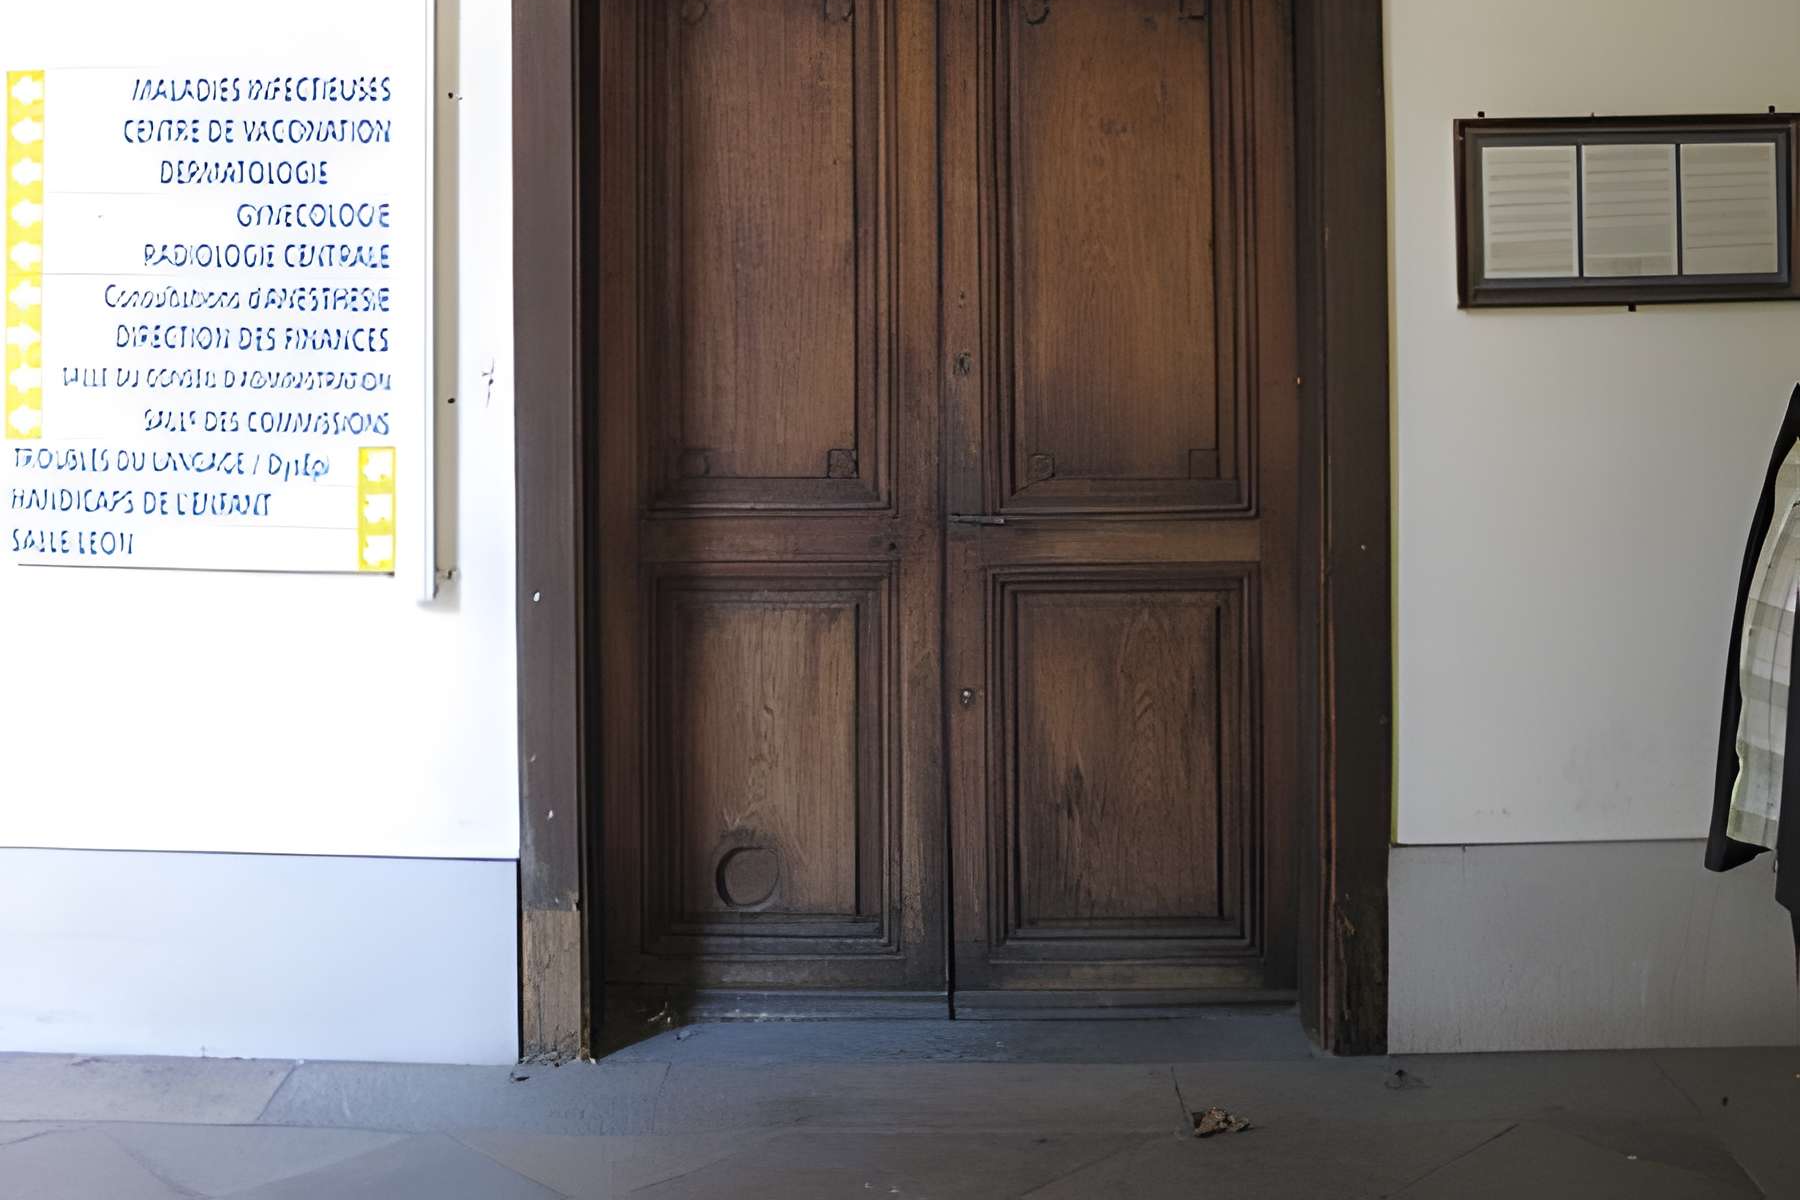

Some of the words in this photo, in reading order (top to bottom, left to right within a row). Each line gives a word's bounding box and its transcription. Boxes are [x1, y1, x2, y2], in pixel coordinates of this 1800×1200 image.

[209, 120, 234, 143] DE
[239, 327, 275, 351] DES
[144, 491, 168, 515] DE
